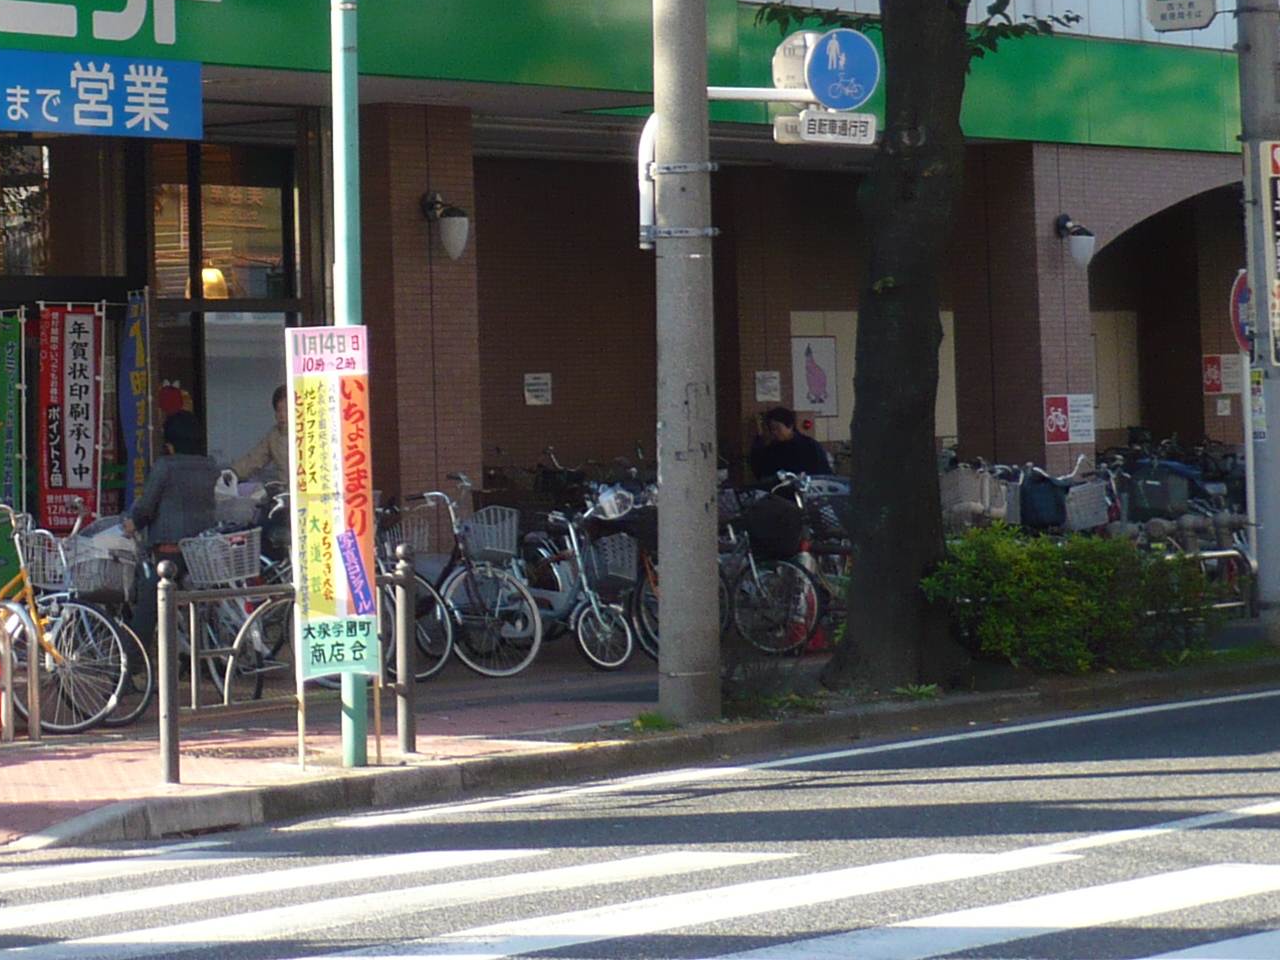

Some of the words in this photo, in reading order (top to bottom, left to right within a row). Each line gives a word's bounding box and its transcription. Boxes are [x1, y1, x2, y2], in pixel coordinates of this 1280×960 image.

[807, 118, 869, 138] 自転車通行可
[293, 332, 347, 357] 11月14日
[68, 321, 90, 482] 年賀状印刷承り中
[48, 406, 63, 487] ポイント2倍
[340, 378, 368, 536] いちょうまつり
[303, 620, 372, 640] 大泉学園町
[310, 640, 367, 665] 商店会
